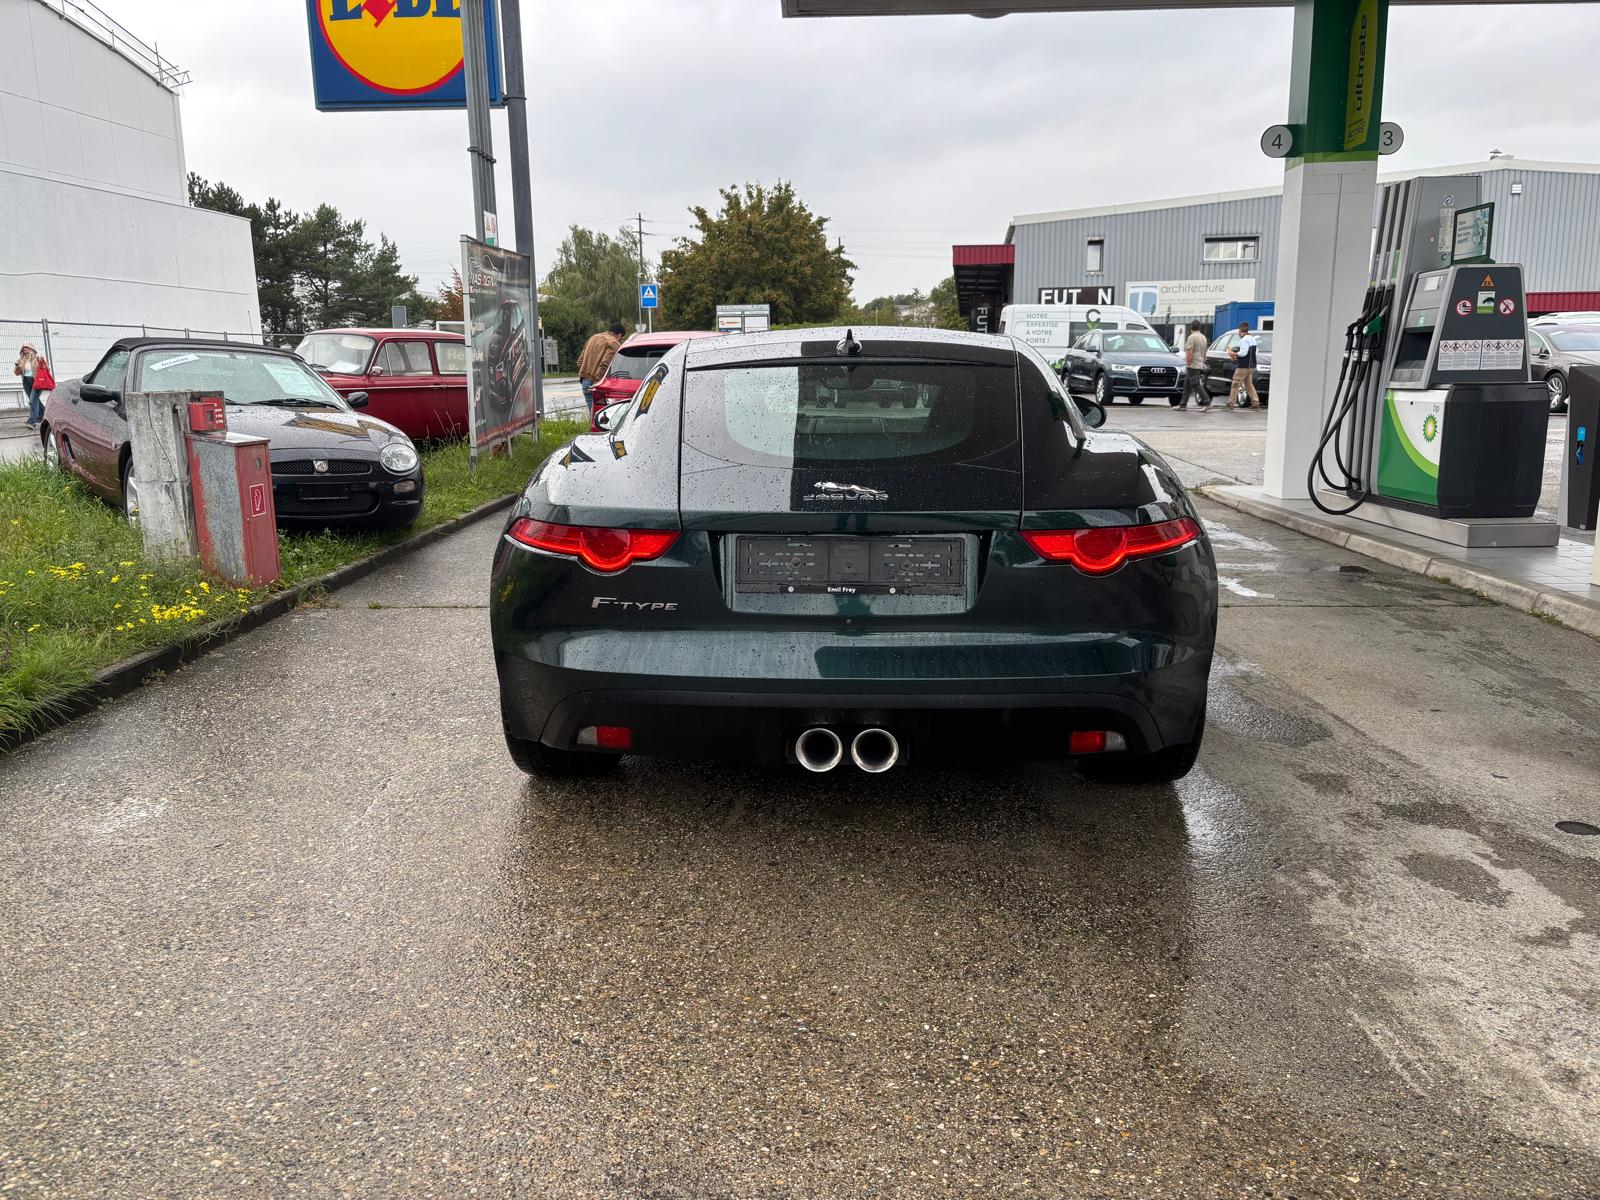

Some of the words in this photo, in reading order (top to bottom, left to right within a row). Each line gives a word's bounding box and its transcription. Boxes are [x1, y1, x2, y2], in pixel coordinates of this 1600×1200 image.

[1355, 15, 1368, 111] ultimate
[1271, 133, 1283, 149] 4
[1383, 130, 1393, 146] 3
[1160, 284, 1225, 294] architecture
[842, 586, 856, 594] Frey
[591, 596, 679, 611] F-TYPE
